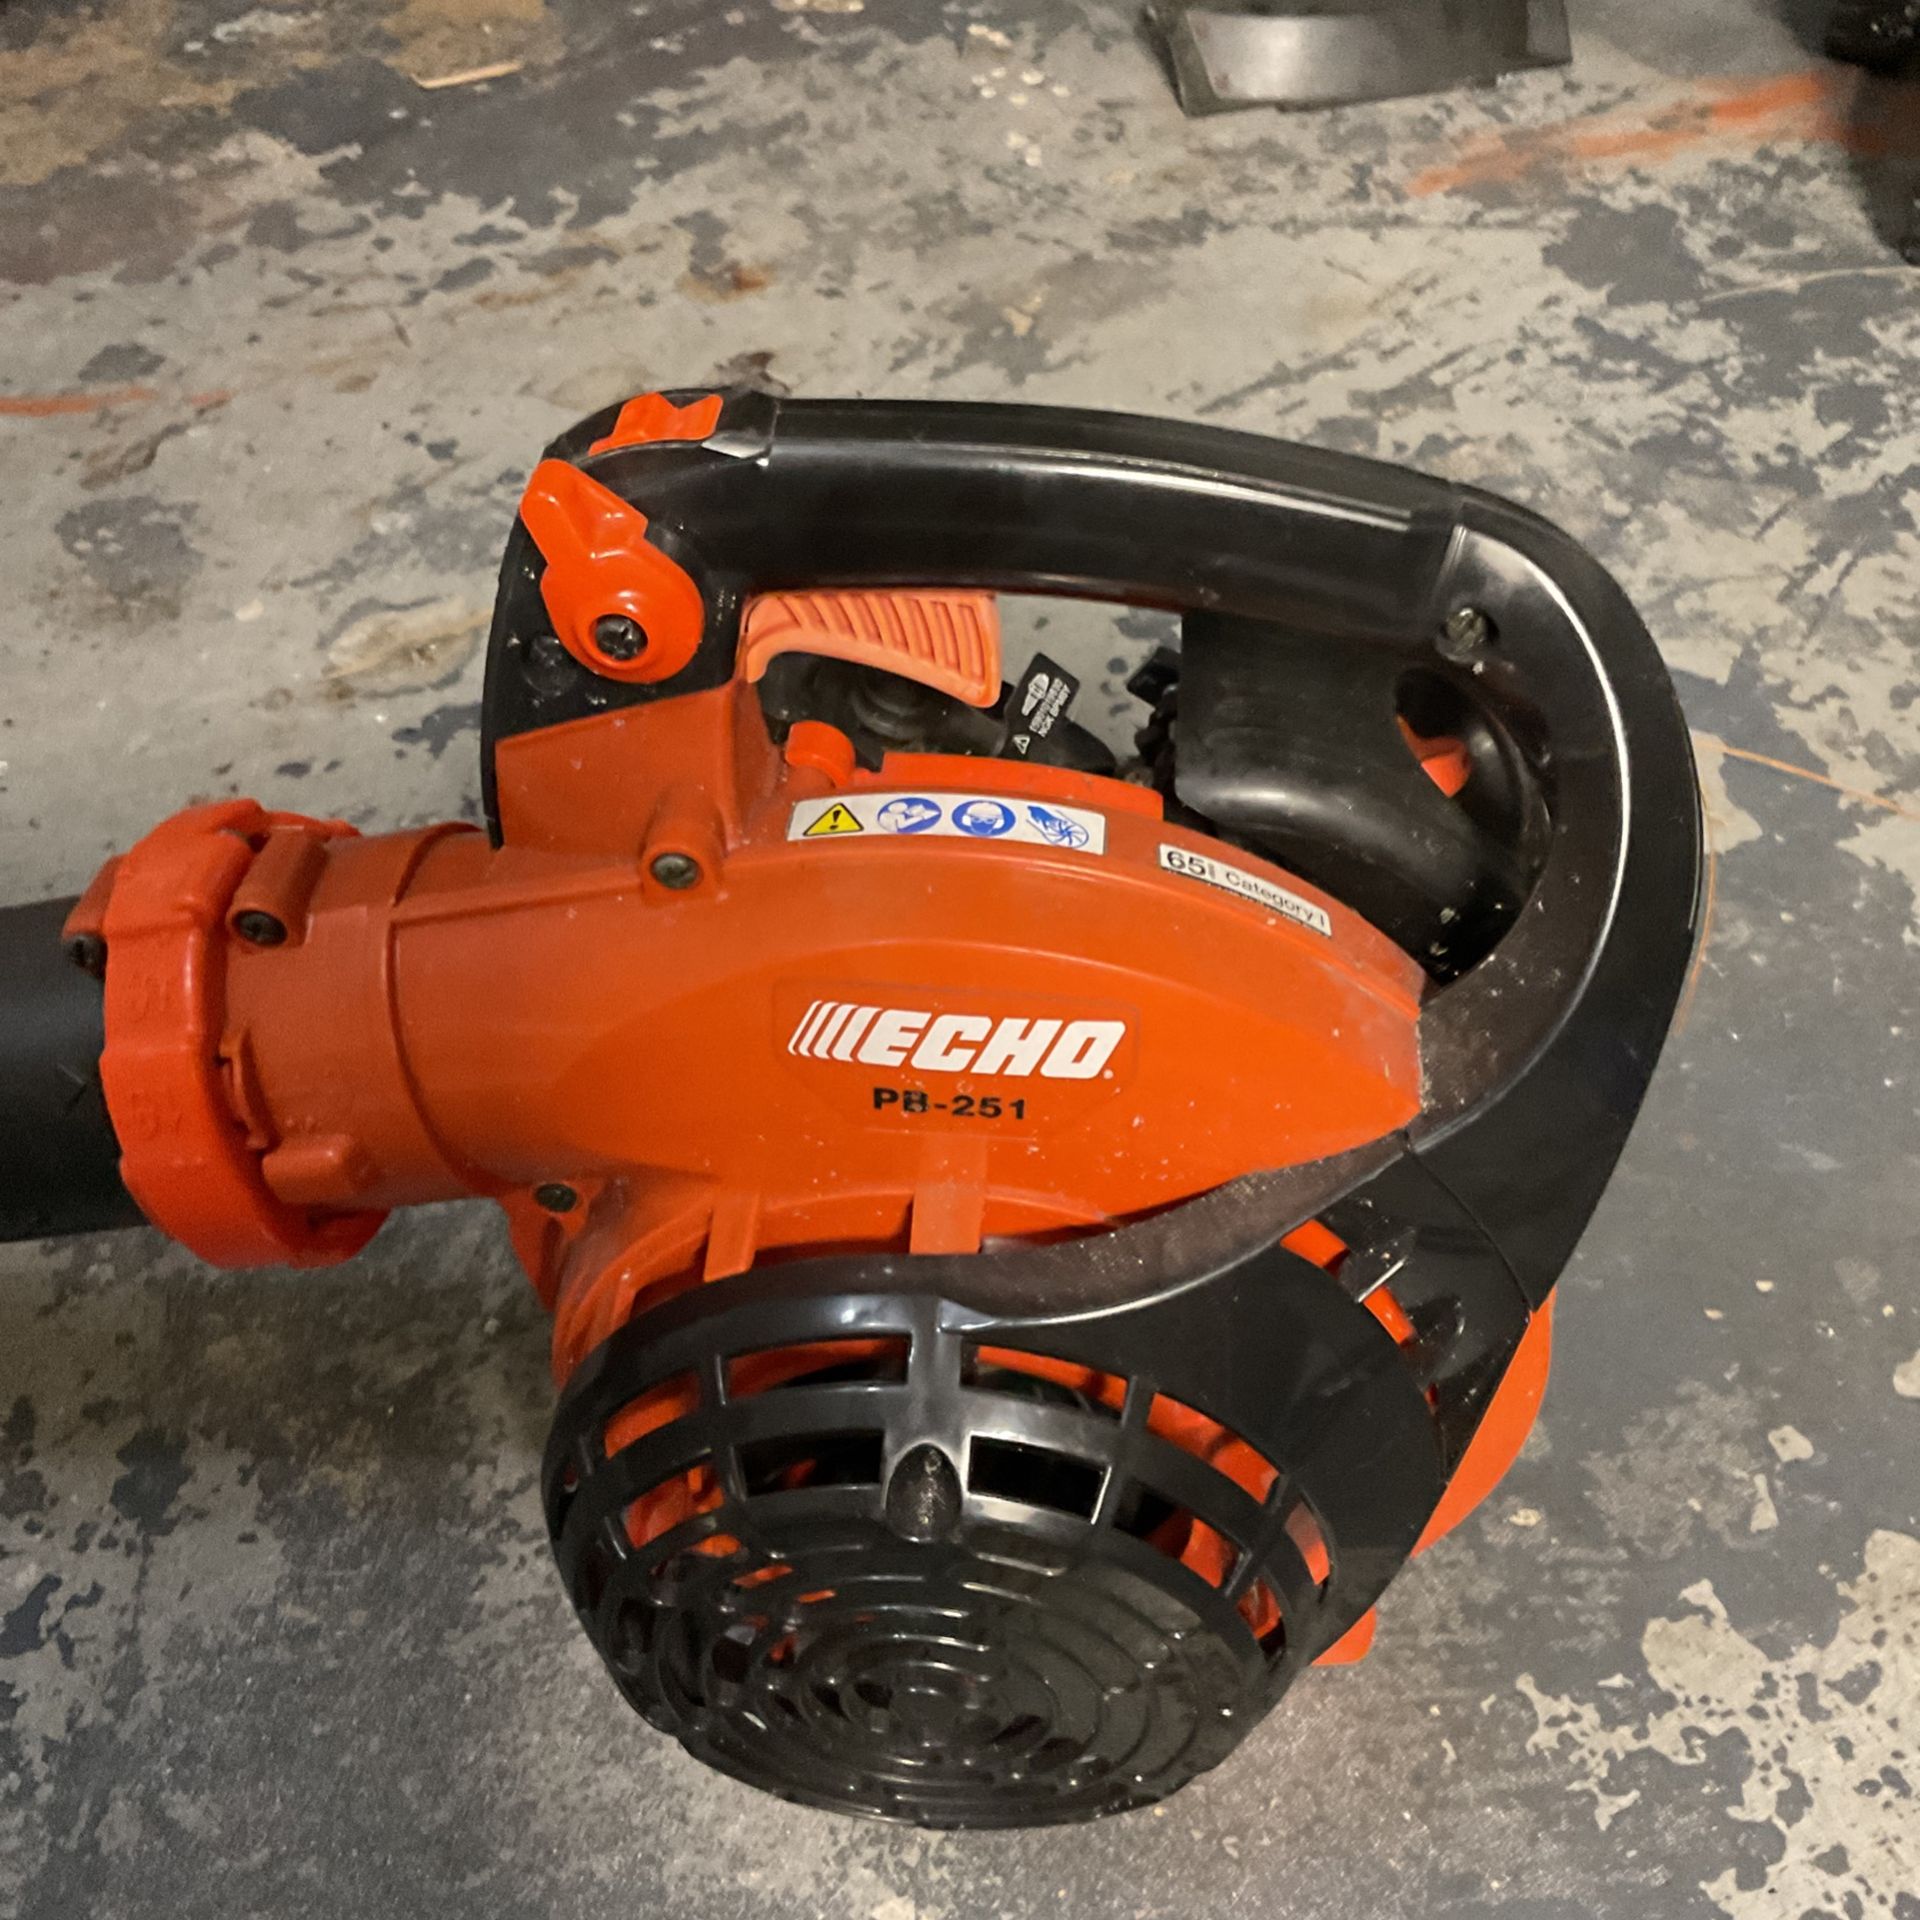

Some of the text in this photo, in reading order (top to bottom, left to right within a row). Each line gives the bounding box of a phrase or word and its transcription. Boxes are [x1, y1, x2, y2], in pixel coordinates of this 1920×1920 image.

[1226, 871, 1313, 921] Category
[857, 1009, 1126, 1080] ECHO
[872, 1087, 1026, 1120] PB-251
